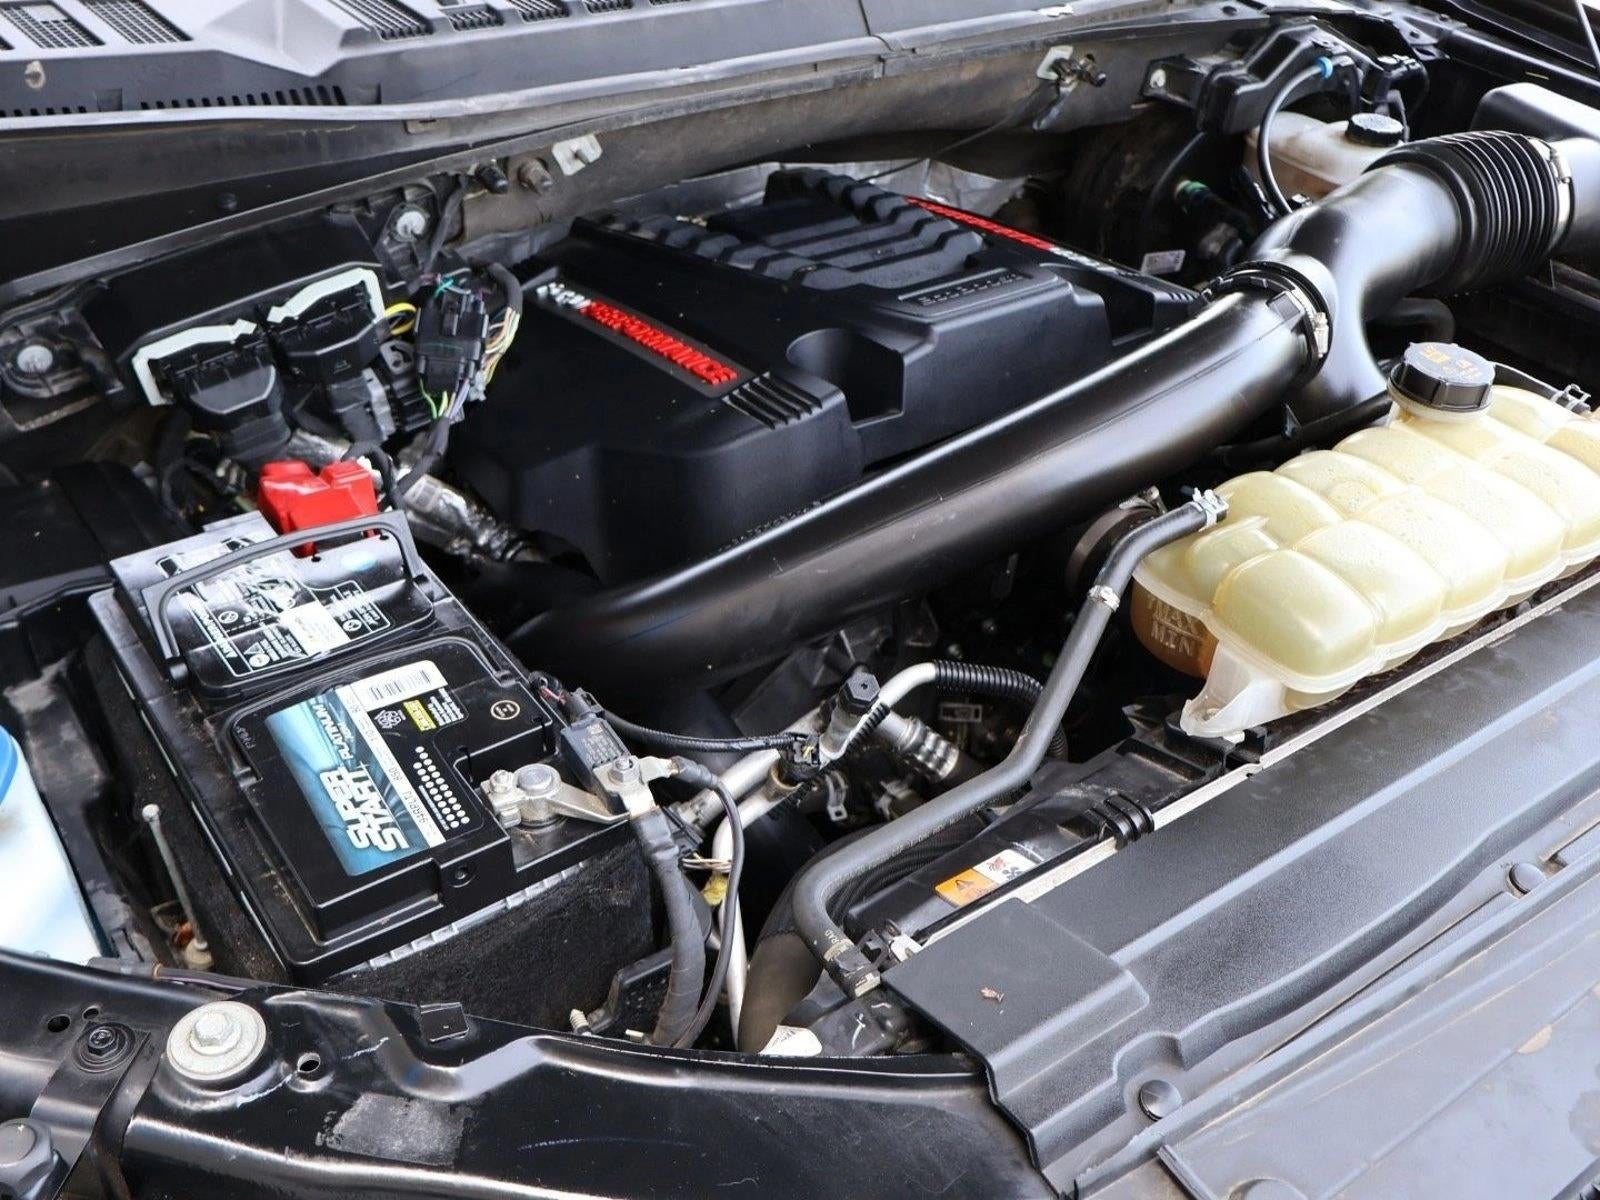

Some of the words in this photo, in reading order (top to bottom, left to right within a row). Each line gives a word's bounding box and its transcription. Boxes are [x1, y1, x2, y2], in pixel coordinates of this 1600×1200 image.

[313, 705, 353, 760] PLATINUM
[319, 768, 375, 849] SUPER
[339, 765, 410, 852] START
